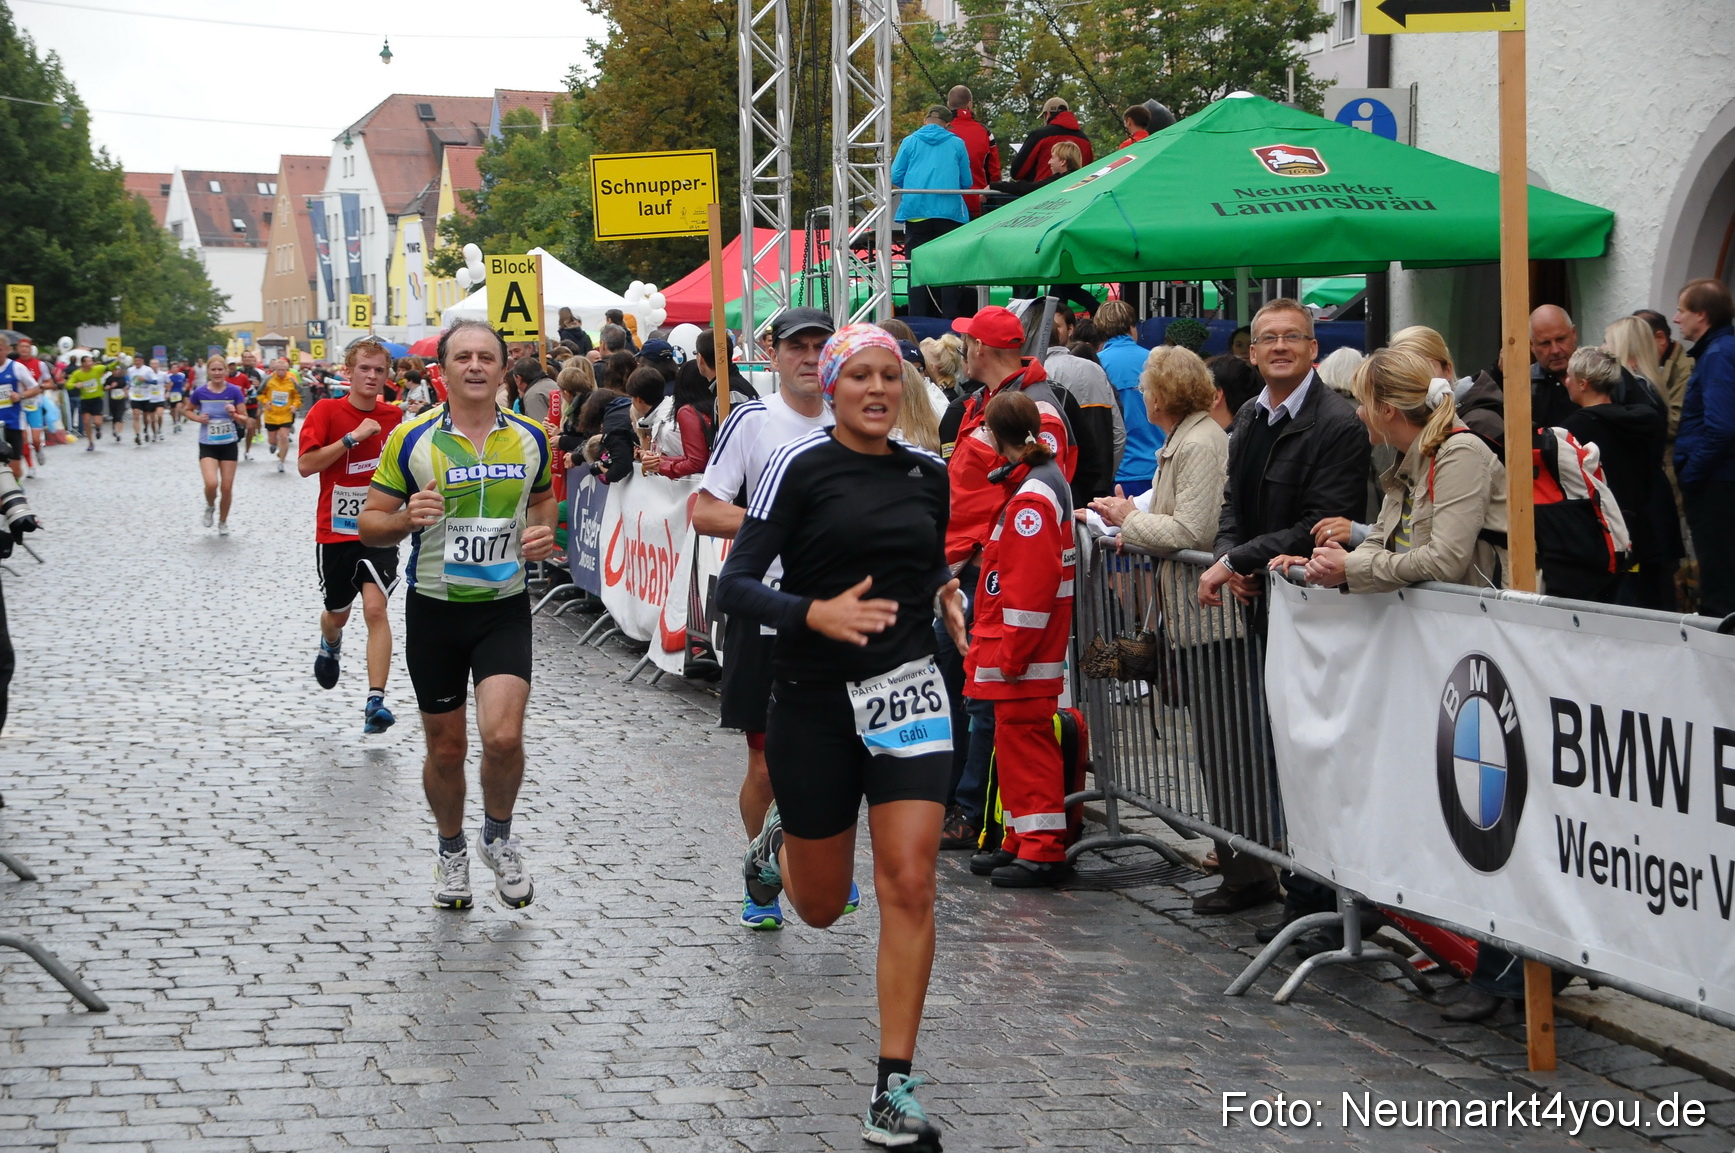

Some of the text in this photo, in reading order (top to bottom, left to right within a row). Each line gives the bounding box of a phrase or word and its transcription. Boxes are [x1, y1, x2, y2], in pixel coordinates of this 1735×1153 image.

[601, 178, 707, 196] Schnupper-
[1233, 182, 1393, 199] Neumarkter
[638, 199, 672, 216] lauf
[1210, 196, 1438, 217] Lammsbräu
[491, 258, 537, 274] Block
[15, 296, 27, 313] B
[500, 281, 533, 323] A
[355, 305, 367, 322] B
[314, 346, 322, 356] C
[447, 464, 526, 483] BOCK
[334, 489, 351, 497] PARTL
[344, 520, 358, 528] Ma
[447, 525, 475, 533] PARTL
[453, 533, 511, 563] 3077
[851, 682, 887, 698] PARTL
[1442, 658, 1520, 735] BMW
[866, 679, 942, 731] 2626
[899, 724, 928, 744] Gabi
[1549, 696, 1694, 815] BMW
[1555, 813, 1703, 916] Weniger
